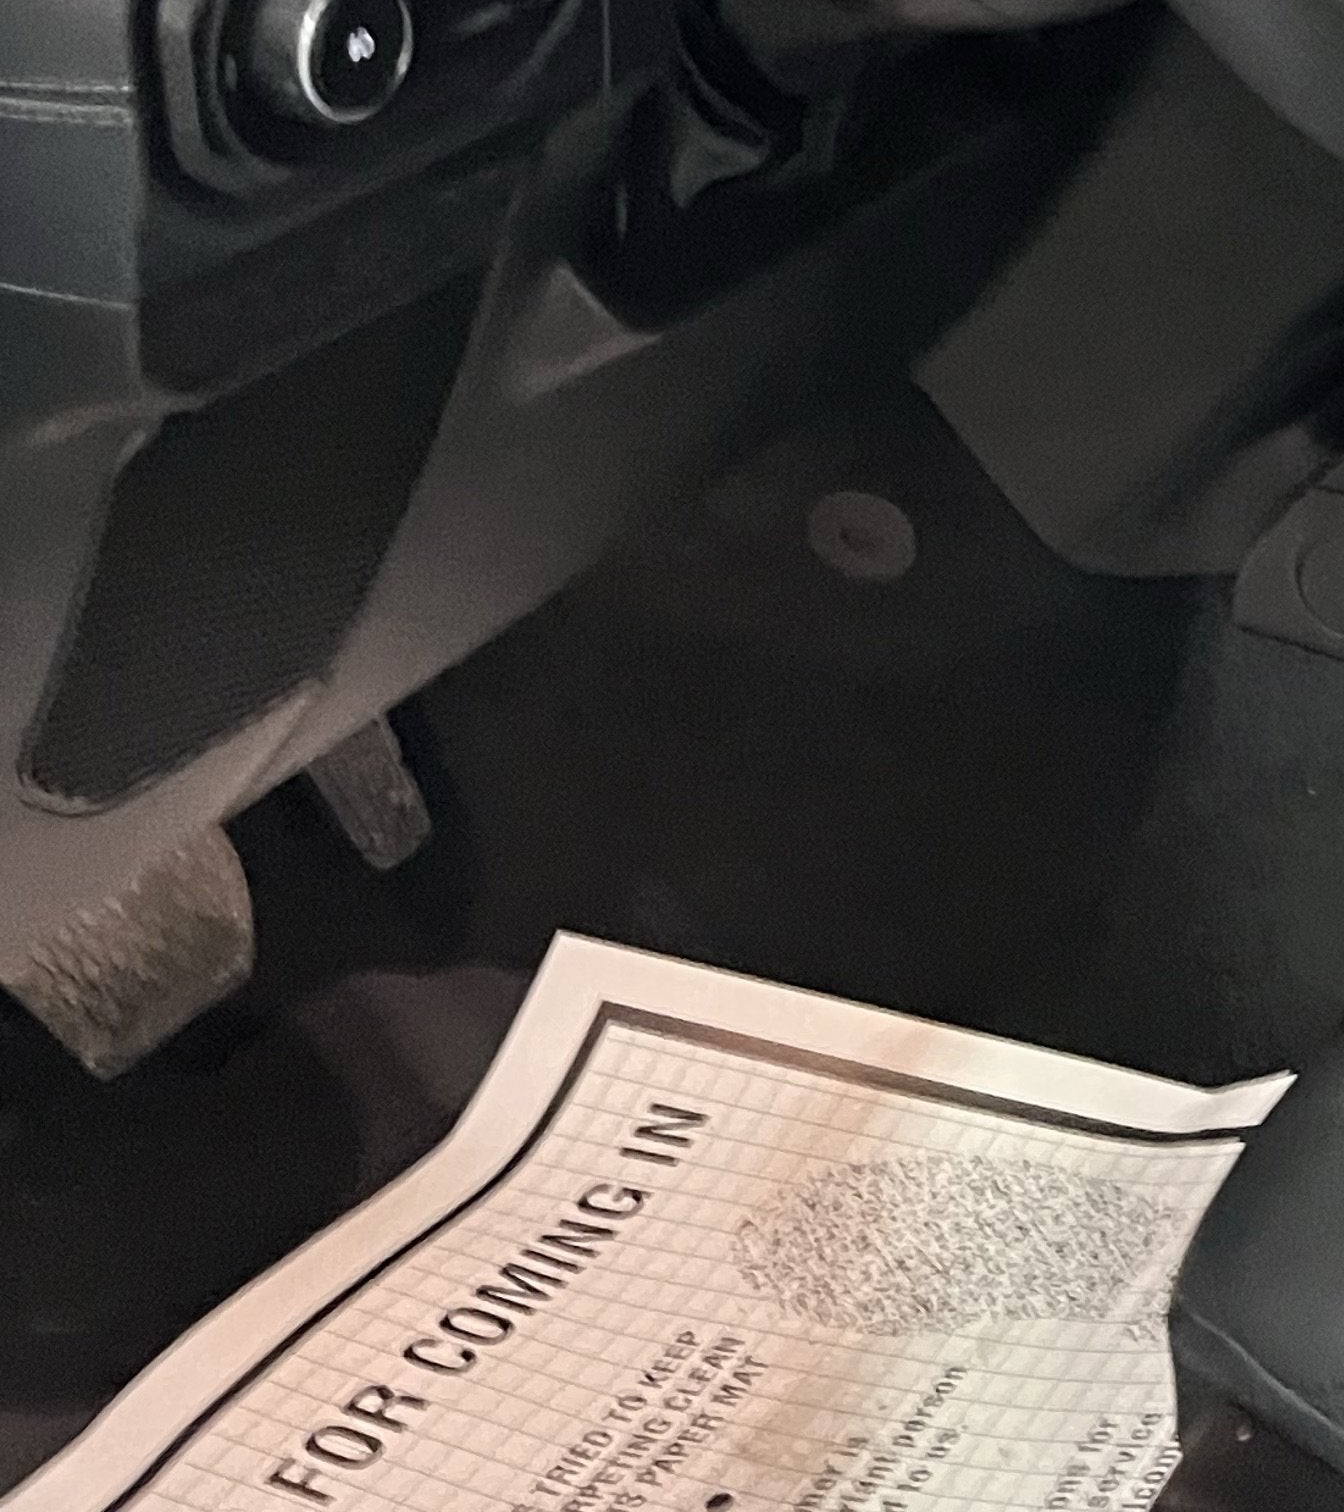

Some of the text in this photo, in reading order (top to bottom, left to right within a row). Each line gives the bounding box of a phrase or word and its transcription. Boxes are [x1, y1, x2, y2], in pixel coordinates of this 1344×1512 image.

[264, 1102, 710, 1507] FOR COMING IN
[529, 1330, 701, 1496] TRIED TO KEEP
[635, 1412, 724, 1487] PAPER
[710, 1355, 769, 1407] MAT
[662, 1336, 746, 1413] CLEAN
[891, 1366, 968, 1448] person
